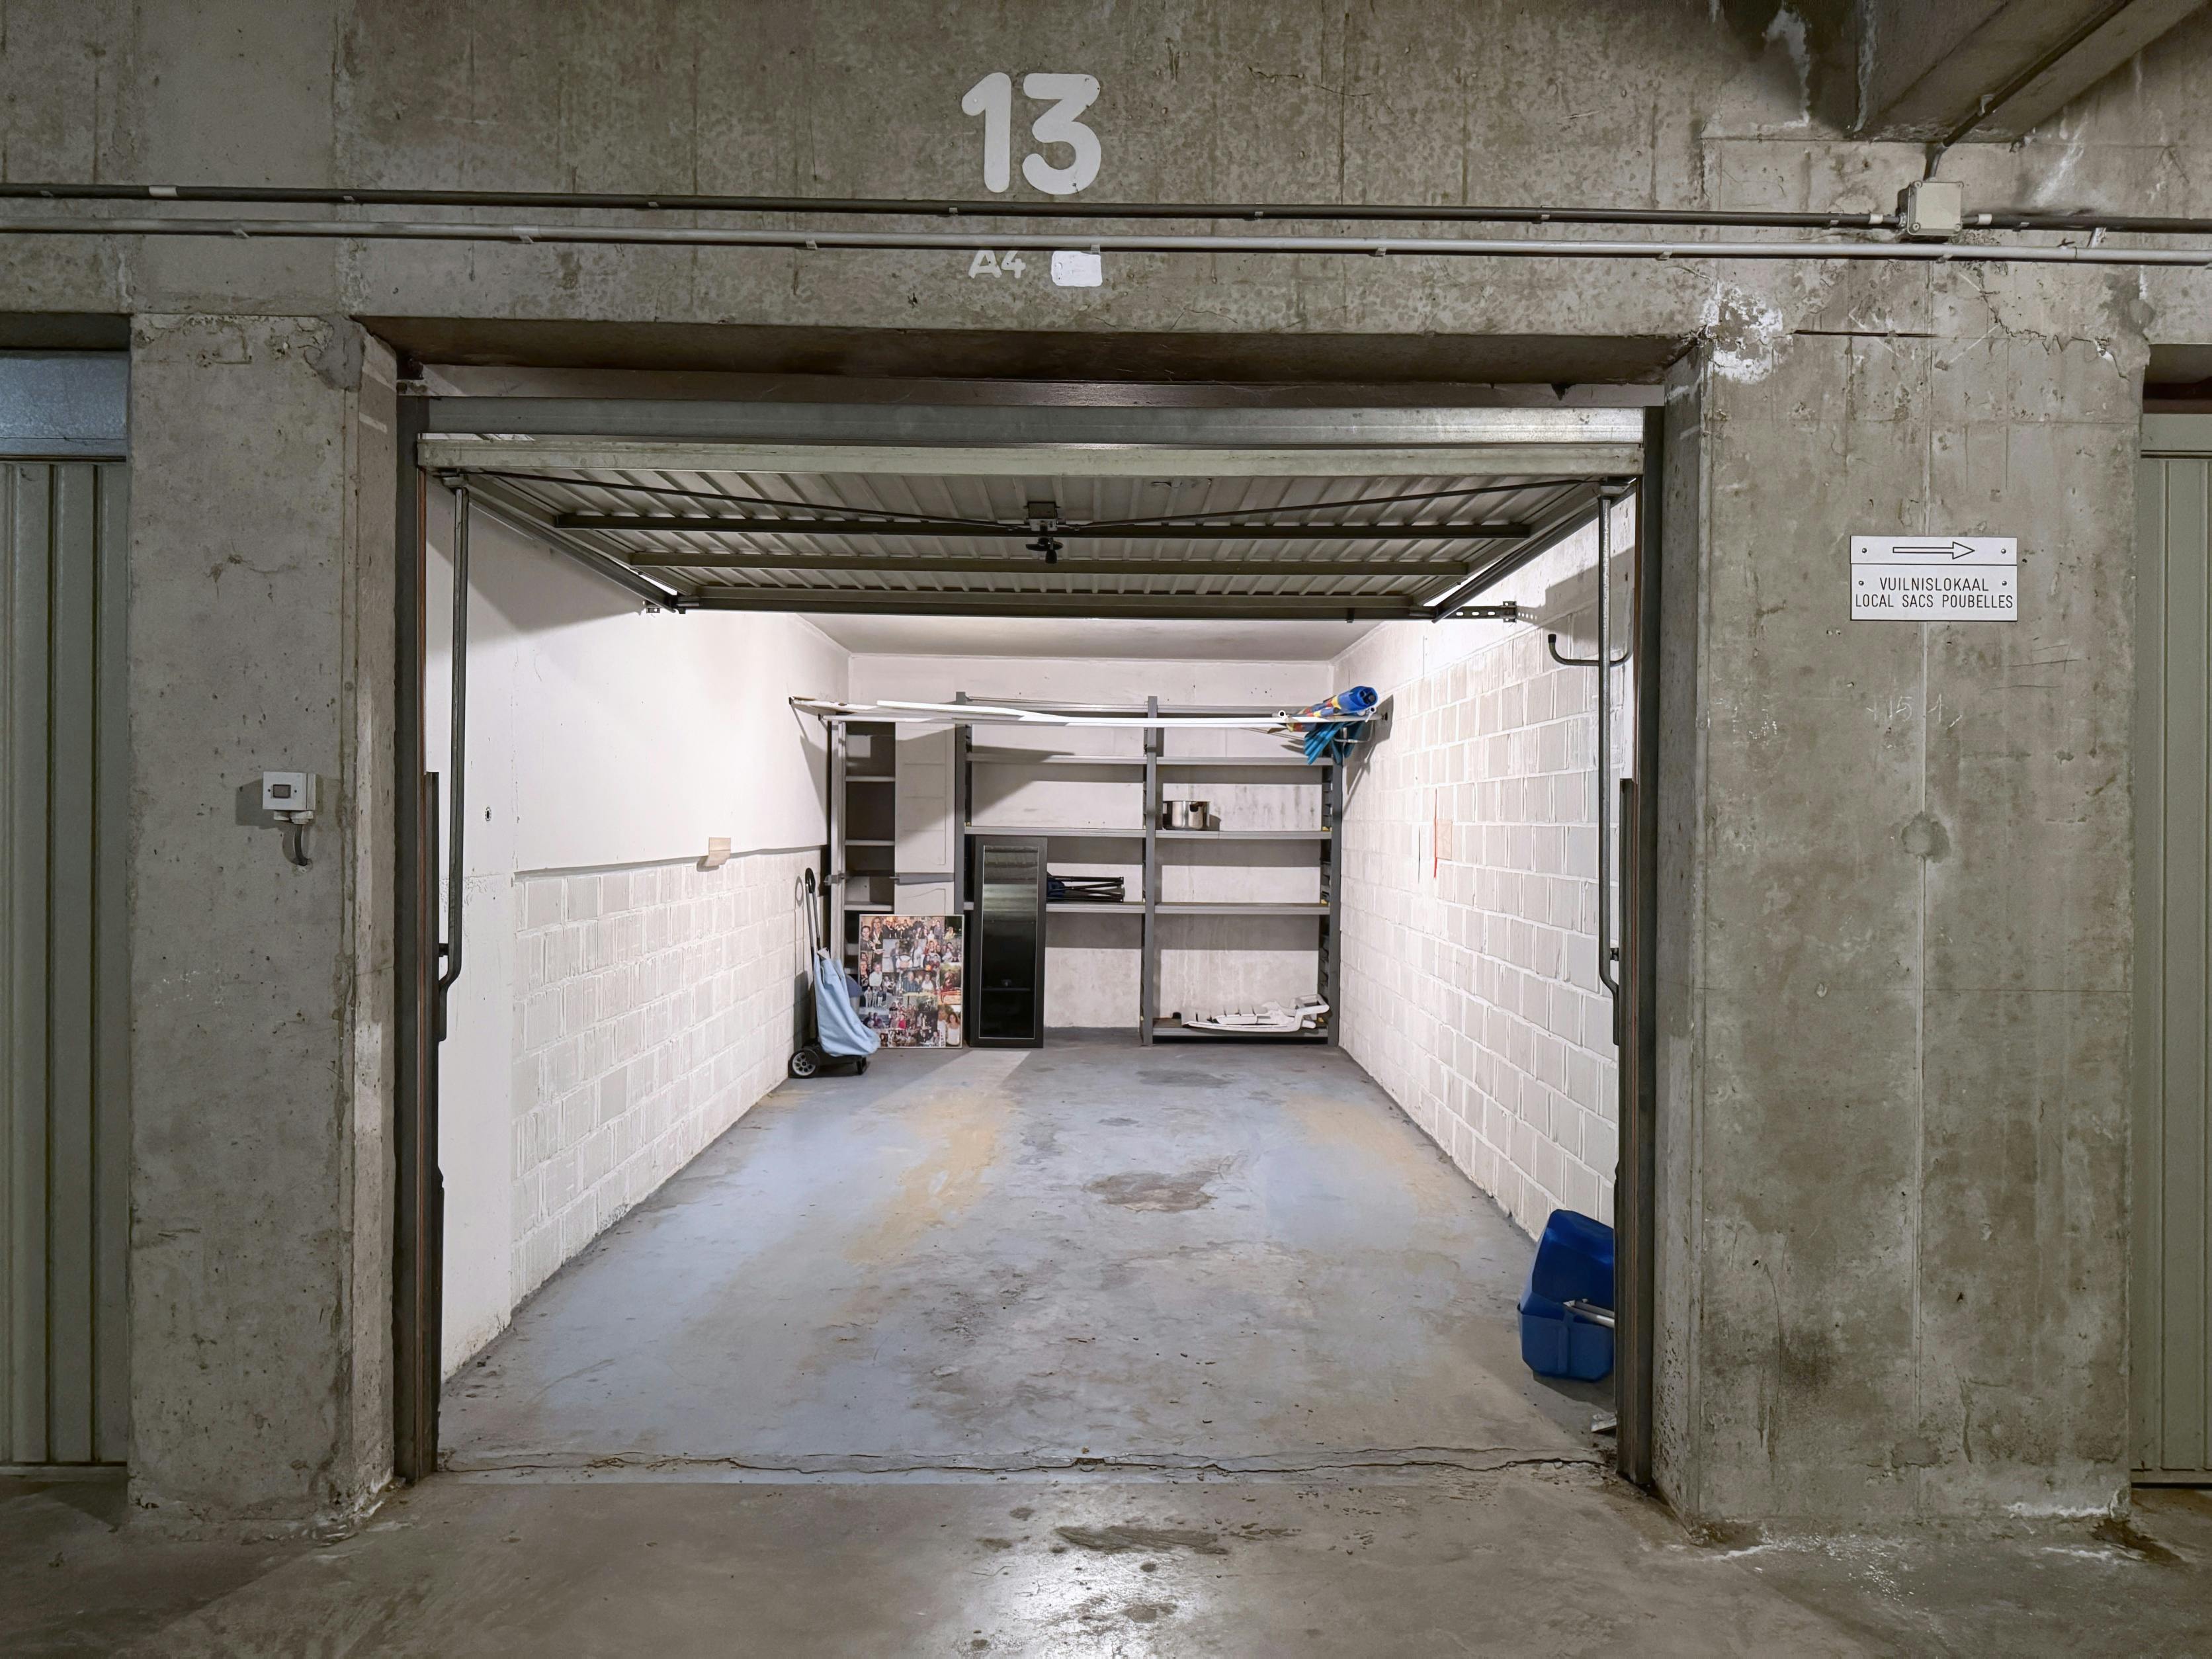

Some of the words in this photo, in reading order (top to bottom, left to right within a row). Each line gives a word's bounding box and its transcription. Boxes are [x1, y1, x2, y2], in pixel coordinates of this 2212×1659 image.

[961, 71, 1102, 195] 13
[968, 249, 1027, 279] A4
[1879, 577, 1990, 591] VUILNISLOKAAL
[1855, 593, 1894, 608] LOCAL
[1902, 593, 1934, 608] SACS
[1942, 594, 2014, 609] POUBELLES
